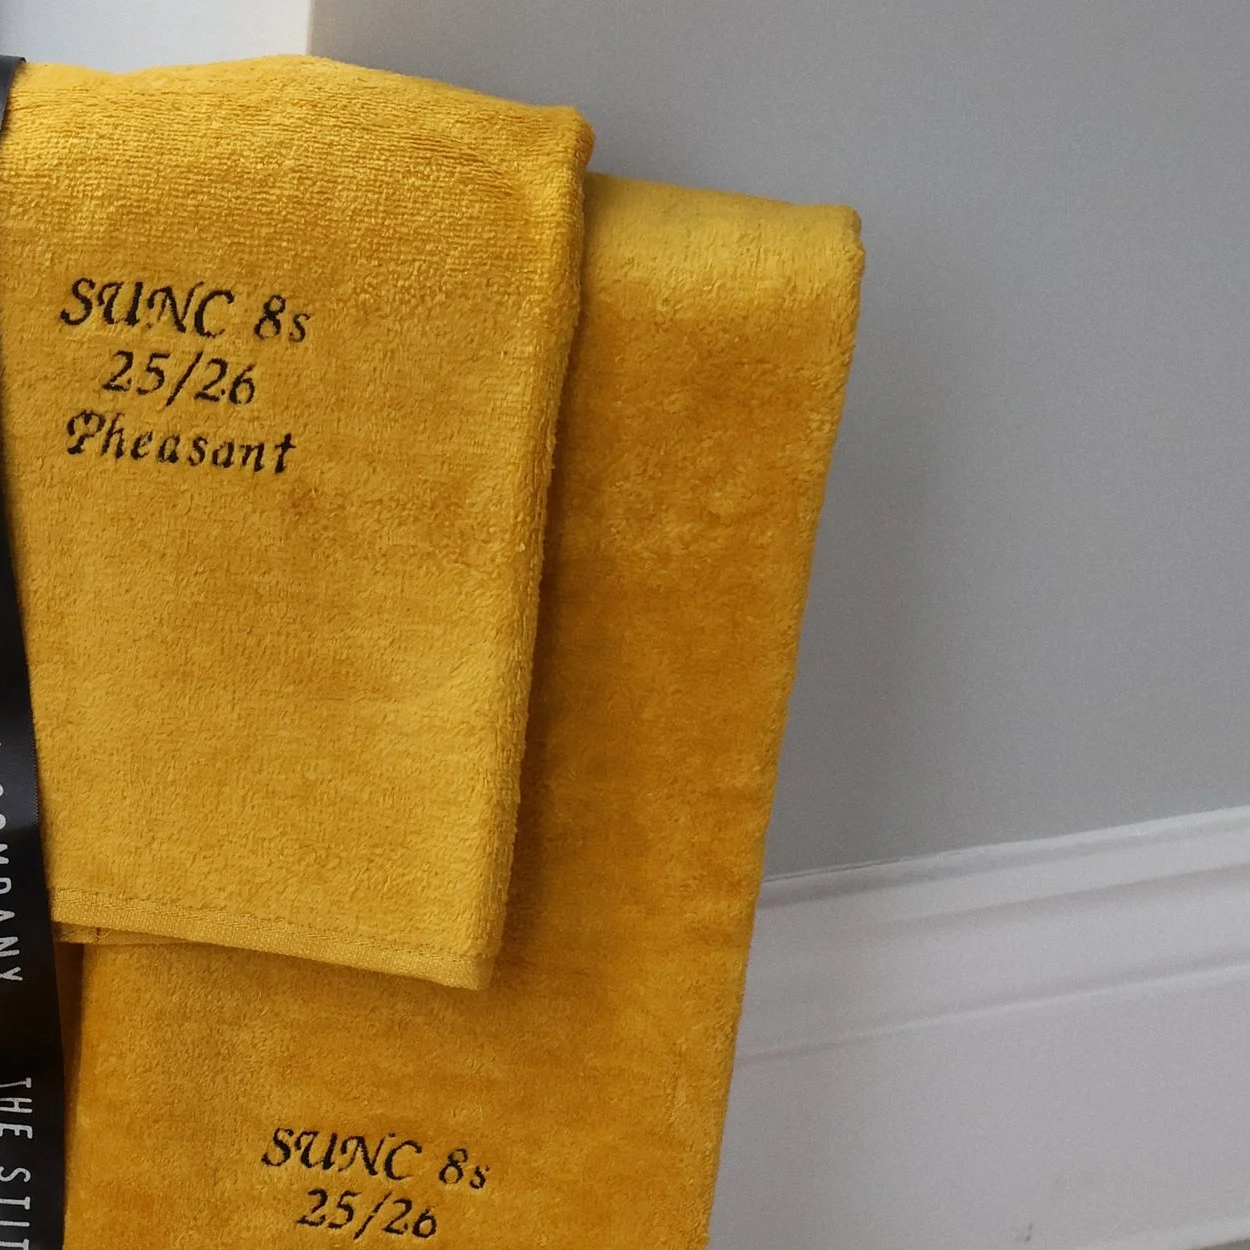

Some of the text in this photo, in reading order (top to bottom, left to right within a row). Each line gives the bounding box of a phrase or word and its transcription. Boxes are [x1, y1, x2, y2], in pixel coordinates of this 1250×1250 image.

[60, 277, 311, 343] SUNC 8s
[101, 351, 256, 407] 25/26
[66, 409, 296, 474] Pheasant
[260, 1127, 491, 1191] SUNC 8s
[296, 1188, 438, 1241] 25/26
